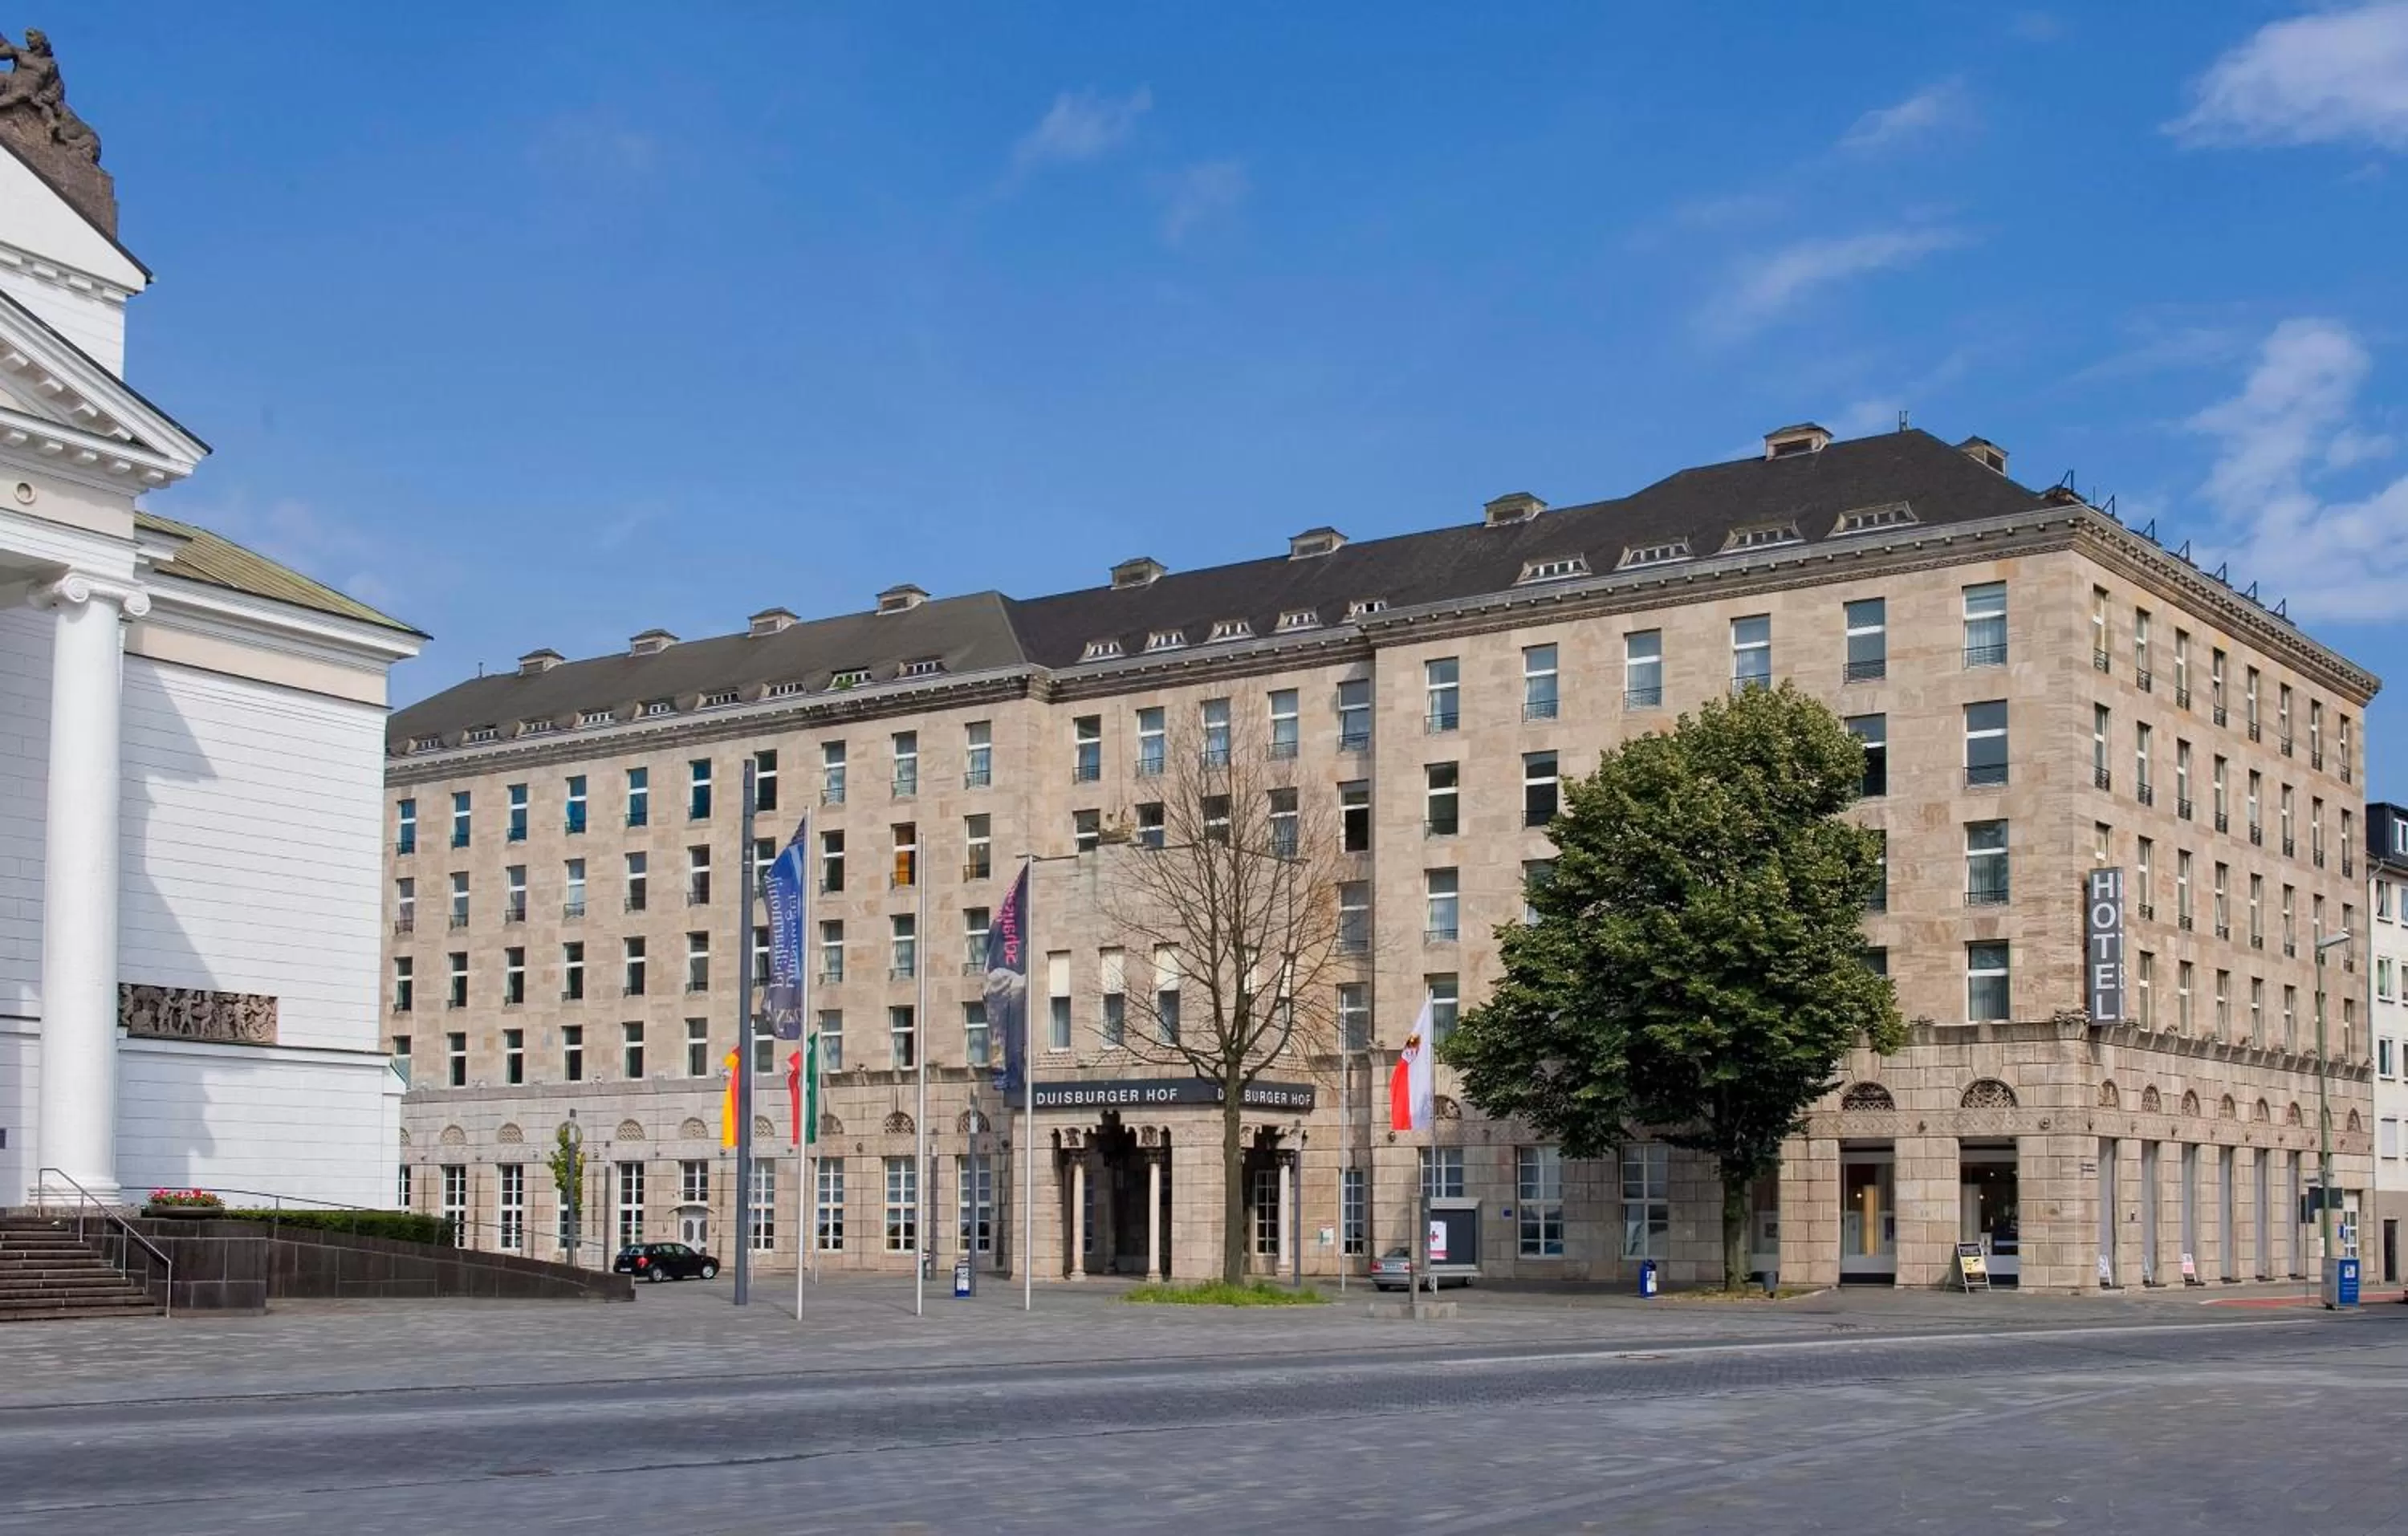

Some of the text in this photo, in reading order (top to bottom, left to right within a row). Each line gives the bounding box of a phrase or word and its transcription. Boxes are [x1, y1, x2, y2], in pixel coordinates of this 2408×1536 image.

[2092, 872, 2117, 1020] HOTEL
[1036, 1088, 1178, 1104] DUISBURGER HOF
[1218, 1087, 1311, 1105] DBURGER HOF
